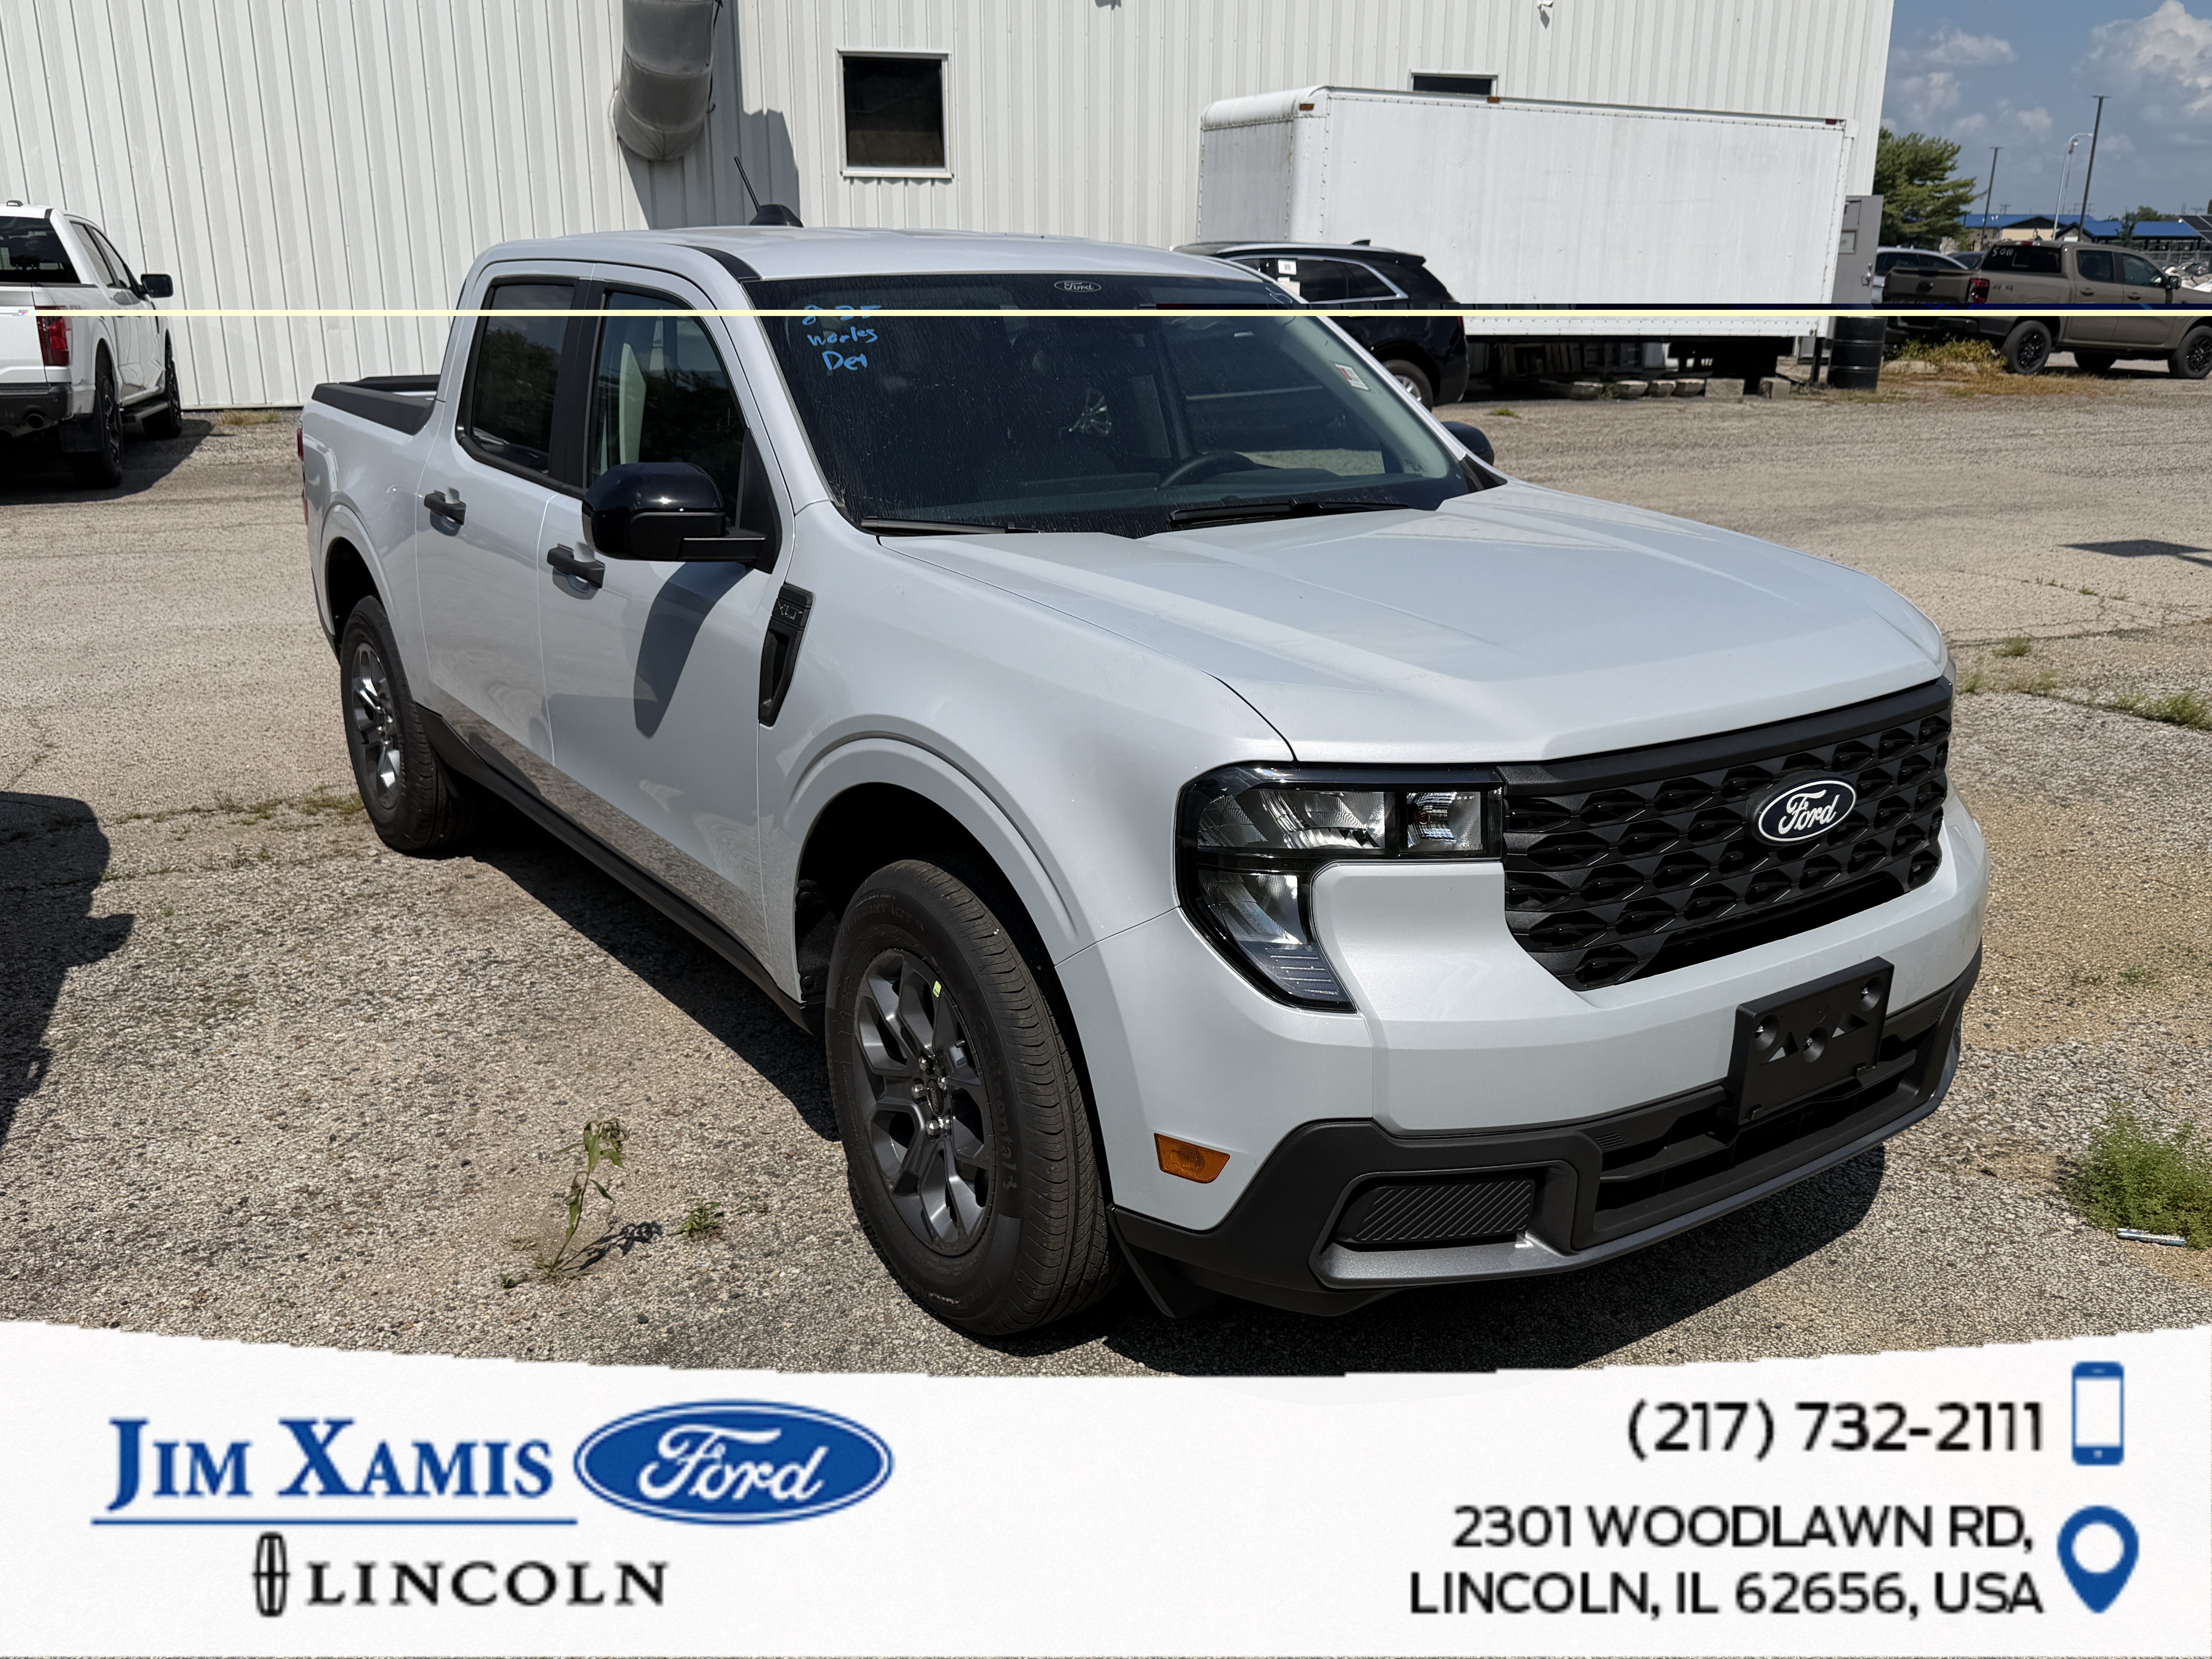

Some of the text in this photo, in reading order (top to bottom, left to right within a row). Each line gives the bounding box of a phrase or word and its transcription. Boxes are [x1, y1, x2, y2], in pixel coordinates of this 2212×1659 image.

[1063, 282, 1094, 291] Ford
[774, 601, 803, 620] XLT
[1778, 789, 1841, 835] Ford
